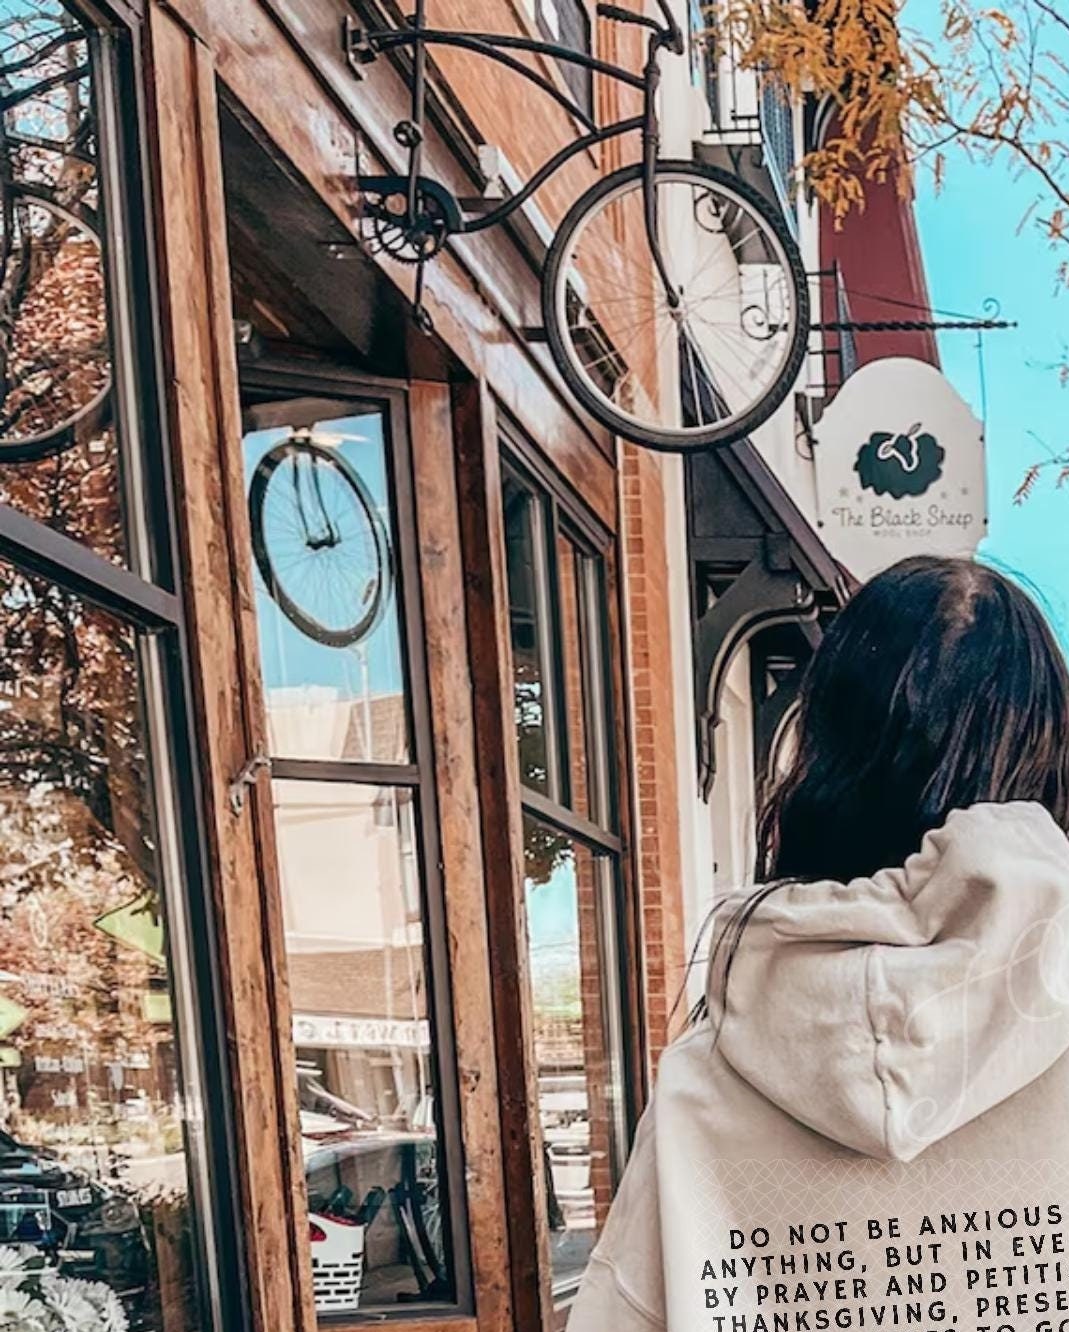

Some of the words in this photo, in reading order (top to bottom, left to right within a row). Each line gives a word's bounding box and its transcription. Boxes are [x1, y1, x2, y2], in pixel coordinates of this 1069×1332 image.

[831, 506, 864, 527] The
[870, 505, 923, 528] Black
[926, 503, 974, 530] Sheep
[730, 1228, 769, 1249] DO
[789, 1222, 847, 1245] NOT
[868, 1218, 900, 1239] BE
[919, 1205, 1062, 1235] ANXIOUS
[701, 1250, 866, 1280] ANYTHING,
[886, 1244, 941, 1267] BUT
[962, 1240, 991, 1261] IN
[705, 1287, 738, 1308] BY
[757, 1279, 867, 1305] PRAYER
[886, 1273, 946, 1296] AND
